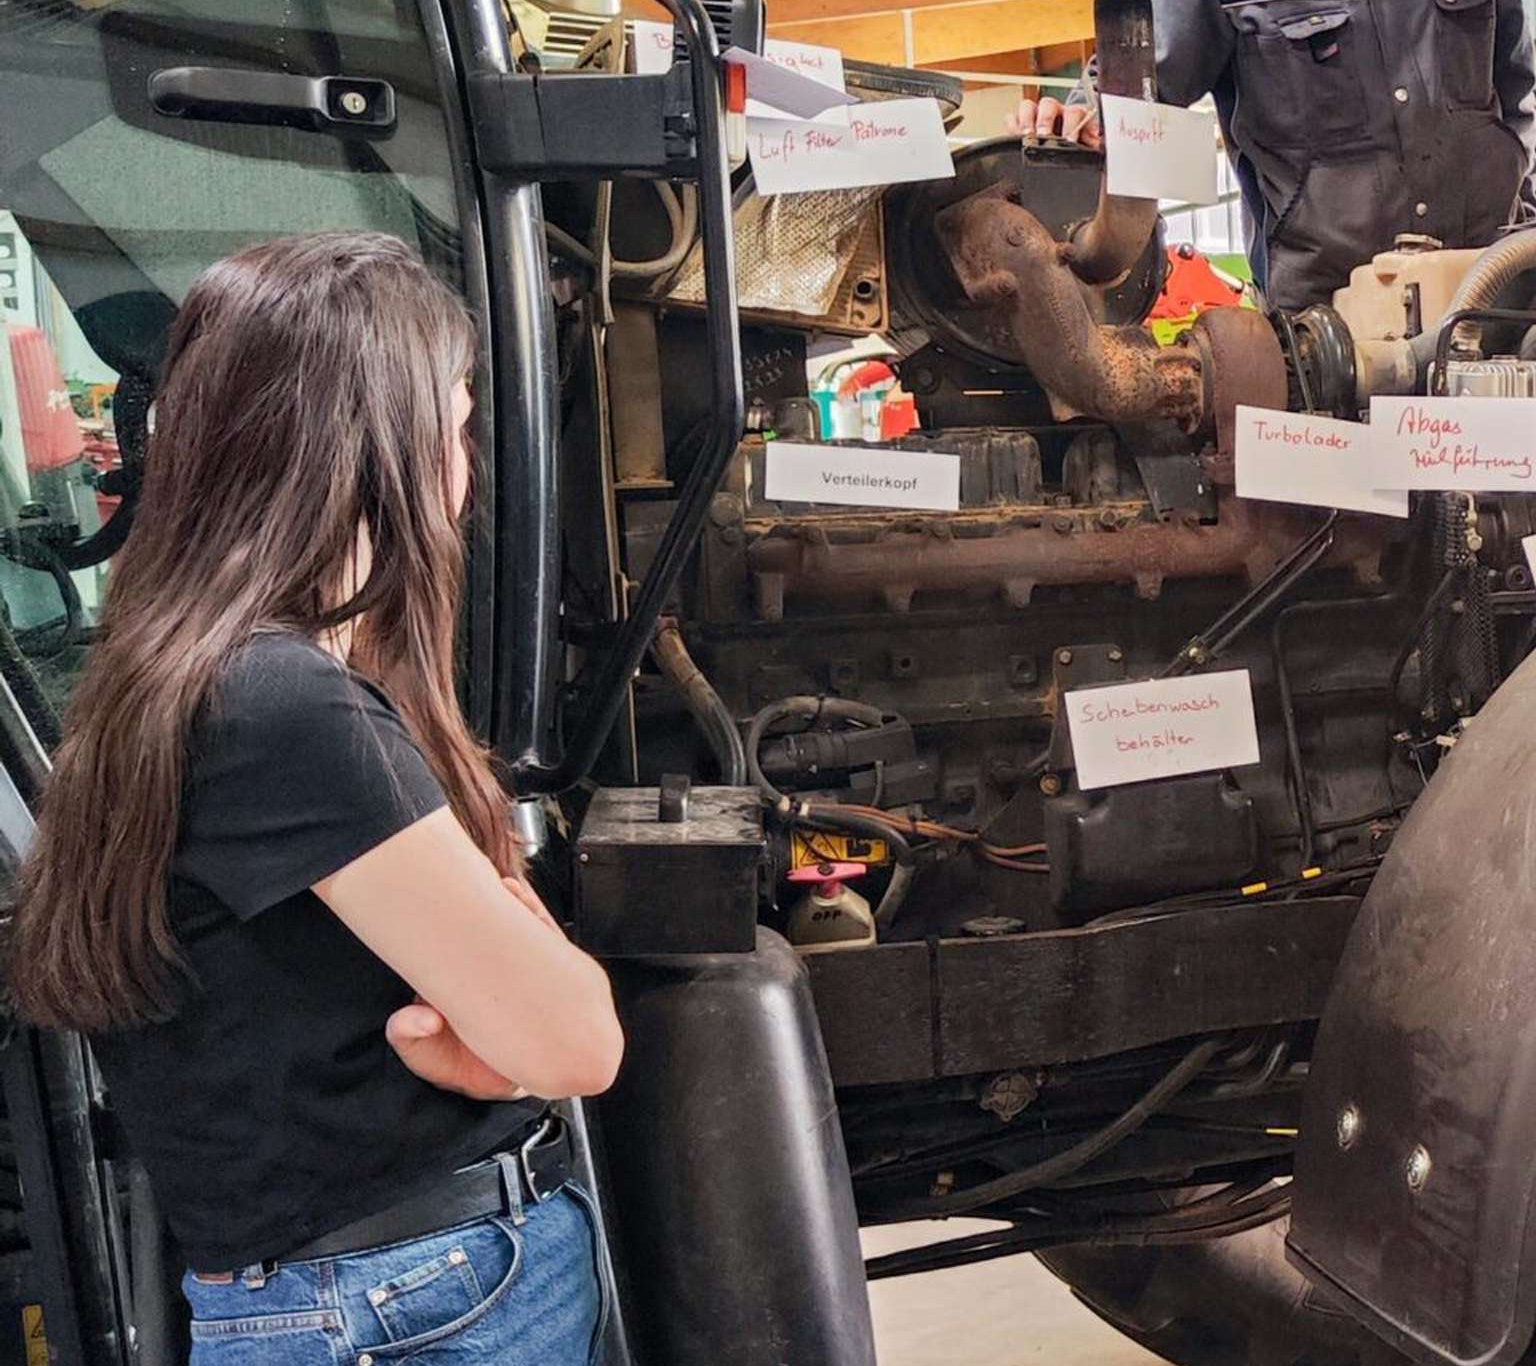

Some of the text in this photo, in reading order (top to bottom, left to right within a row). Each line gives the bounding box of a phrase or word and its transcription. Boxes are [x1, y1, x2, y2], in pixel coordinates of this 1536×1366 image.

[758, 134, 796, 163] Luft
[1253, 421, 1352, 449] Turbolader
[1397, 405, 1462, 447] Abgas
[821, 472, 918, 491] Verteilerkopf
